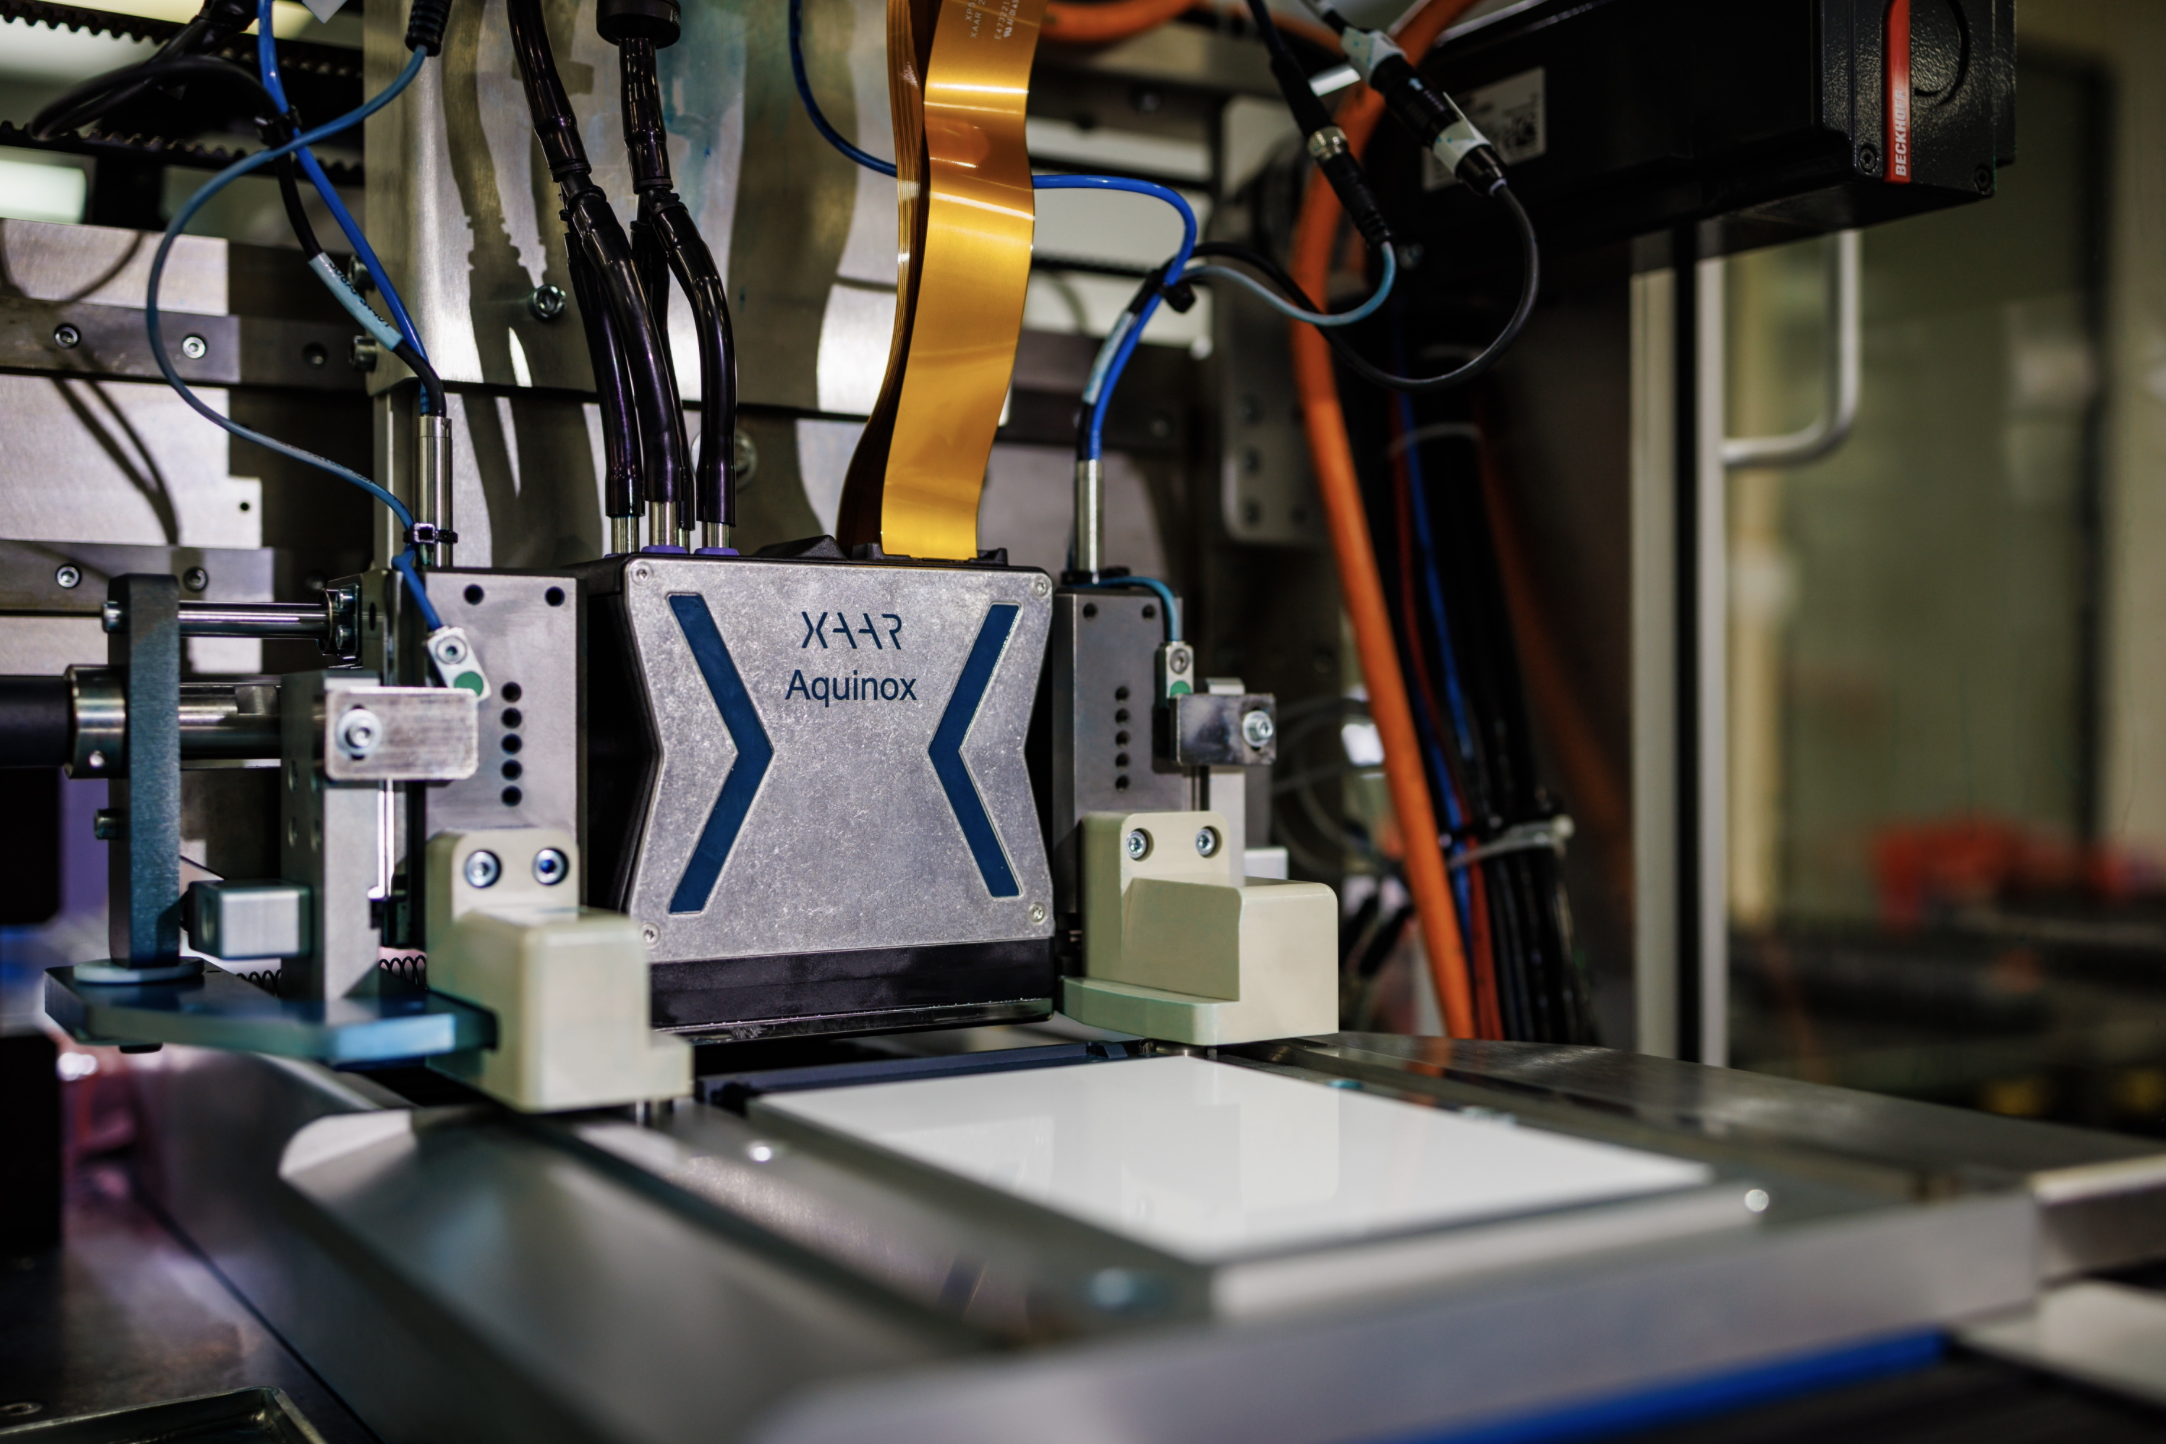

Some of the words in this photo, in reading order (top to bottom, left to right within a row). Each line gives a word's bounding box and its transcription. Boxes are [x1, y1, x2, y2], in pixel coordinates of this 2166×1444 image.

[970, 12, 982, 38] XAAR
[994, 1, 1010, 40] E473221
[1894, 88, 1907, 177] BECKHOFF
[801, 611, 902, 650] XAAR
[785, 669, 917, 708] Aquinox
